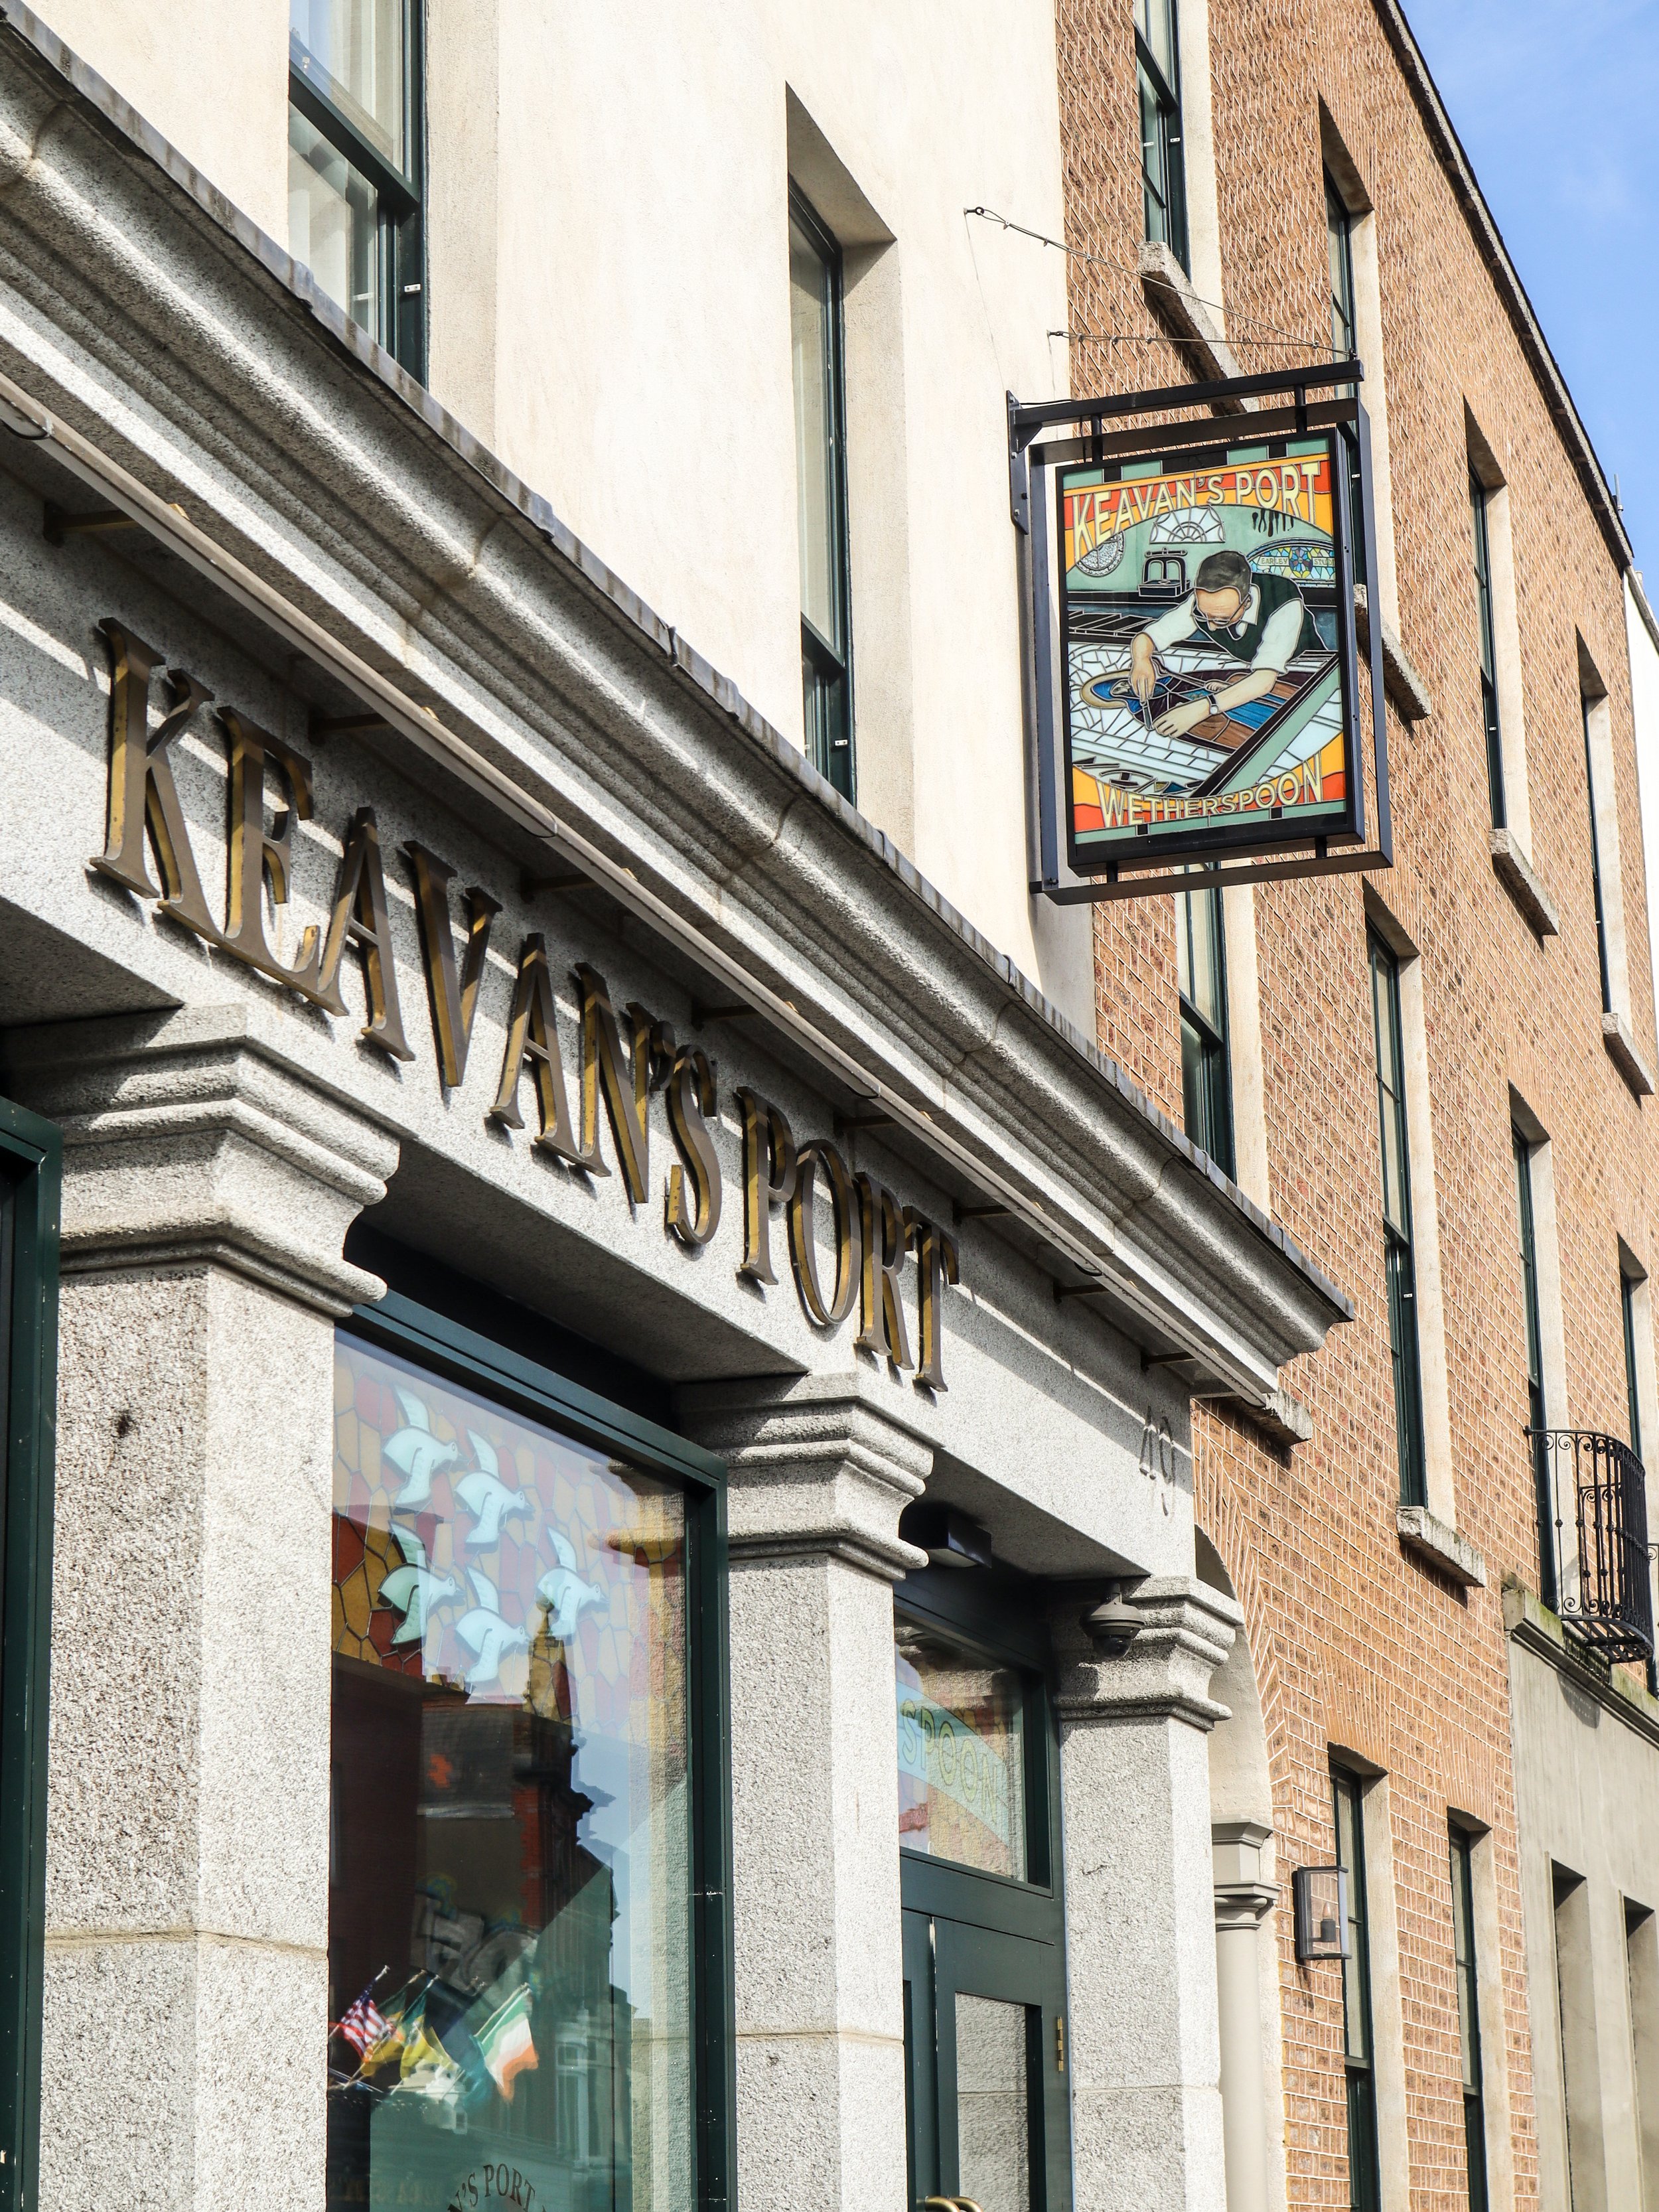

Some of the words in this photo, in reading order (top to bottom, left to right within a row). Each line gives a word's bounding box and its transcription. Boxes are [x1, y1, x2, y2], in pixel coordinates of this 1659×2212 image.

[1072, 474, 1225, 560] KEAVAN'S
[1236, 461, 1320, 524] PORT
[1096, 751, 1323, 828] WETHERSPOON
[89, 617, 722, 1245] KEAVAN'S
[734, 1086, 960, 1392] PORT
[898, 1698, 997, 1826] SPOON
[483, 2164, 536, 2212] PORT
